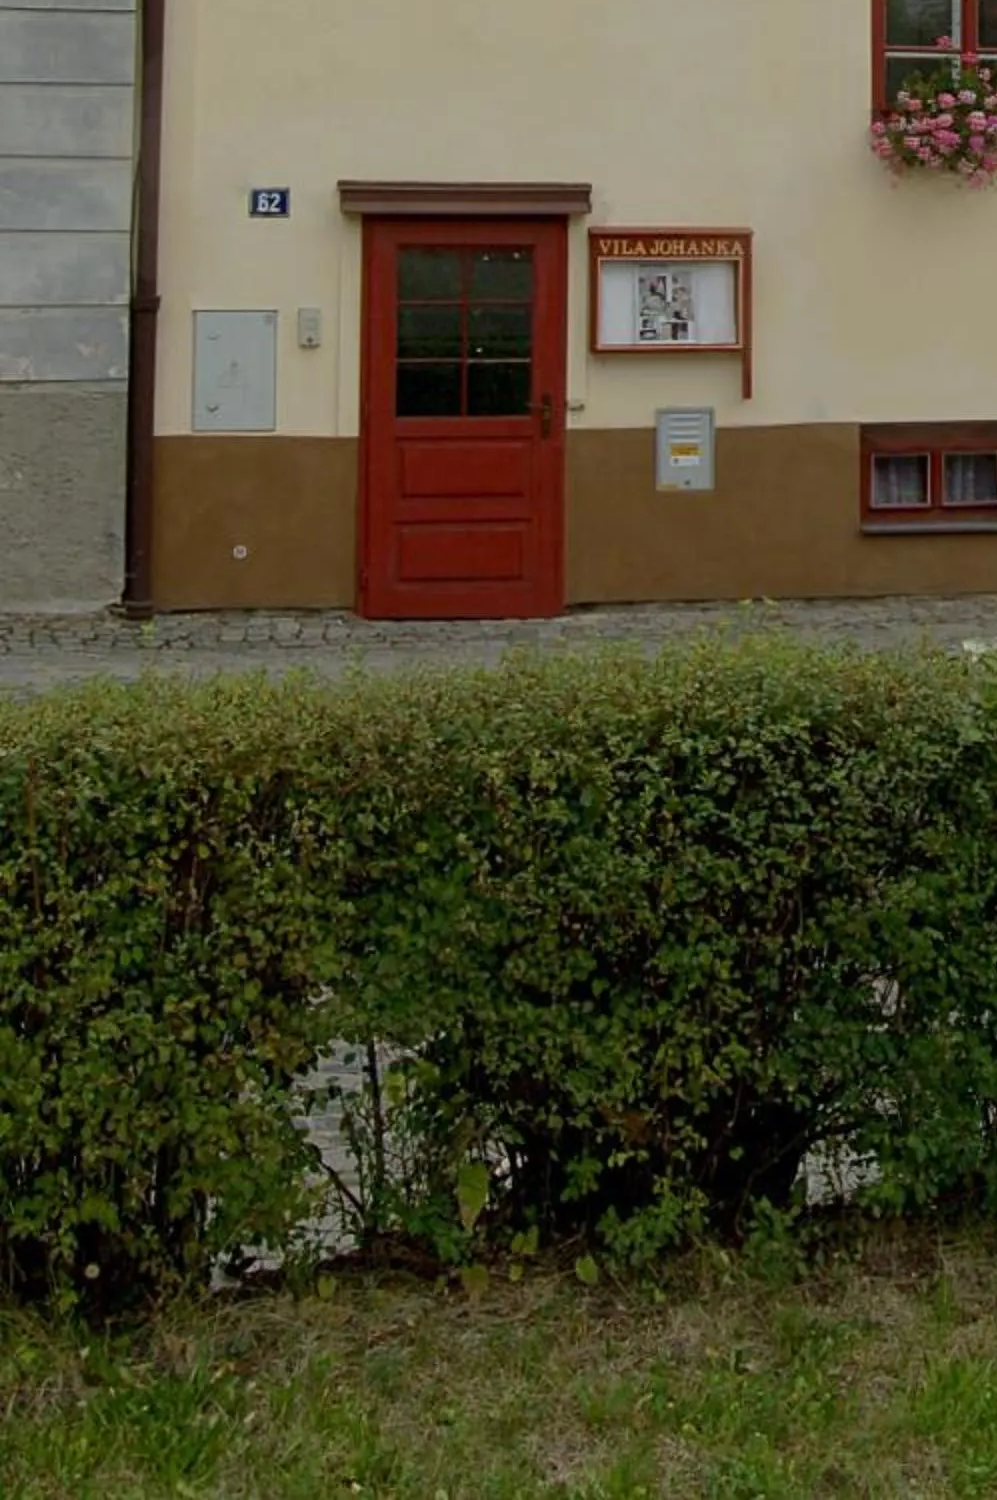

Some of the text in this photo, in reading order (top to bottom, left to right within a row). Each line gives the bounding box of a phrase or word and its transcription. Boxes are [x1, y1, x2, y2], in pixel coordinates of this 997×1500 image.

[257, 192, 280, 212] 62
[600, 240, 744, 255] VILA JOHANKA
